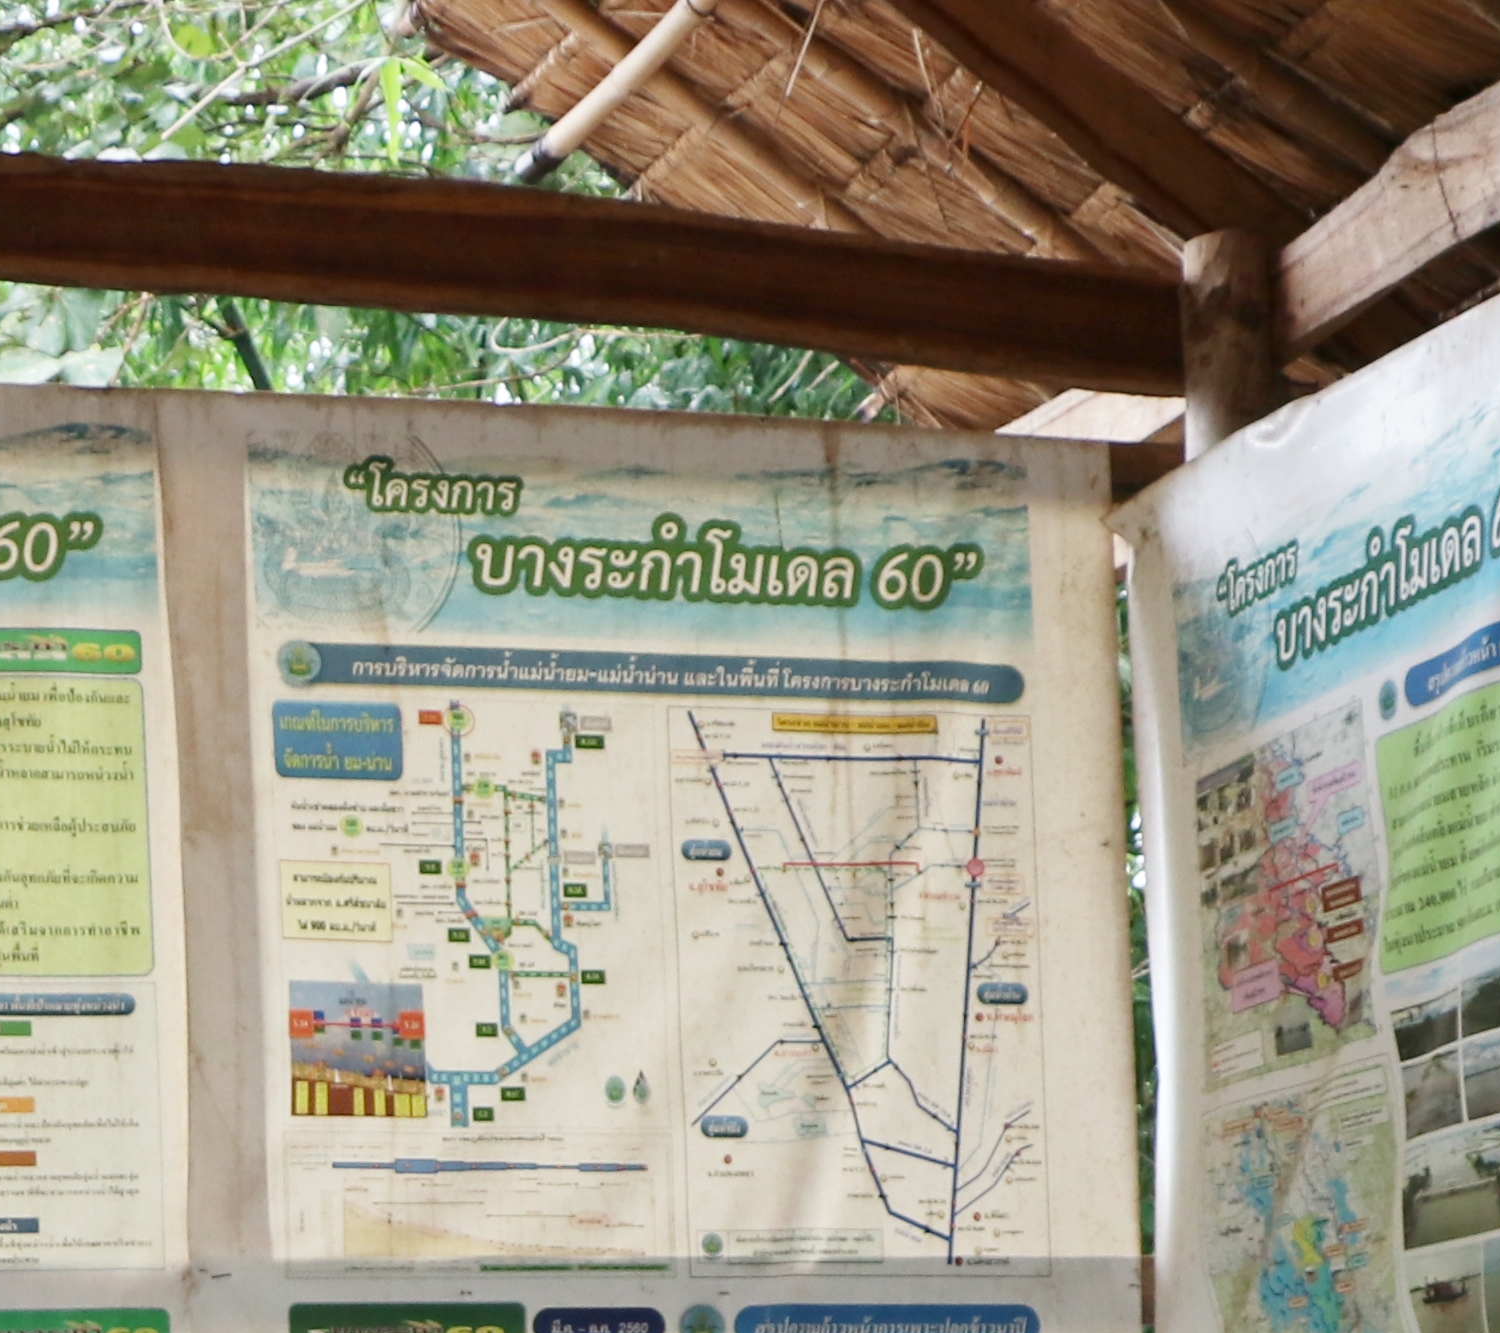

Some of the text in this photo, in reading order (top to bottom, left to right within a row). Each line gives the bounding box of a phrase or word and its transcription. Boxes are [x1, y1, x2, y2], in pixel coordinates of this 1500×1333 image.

[346, 461, 518, 514] “โครงการ
[476, 519, 980, 602] บางระกำโมเดล 60”
[1217, 544, 1299, 612] “โครงการ
[1277, 525, 1482, 661] บางระกำโมเดล
[683, 659, 779, 689] และในพื้นที่
